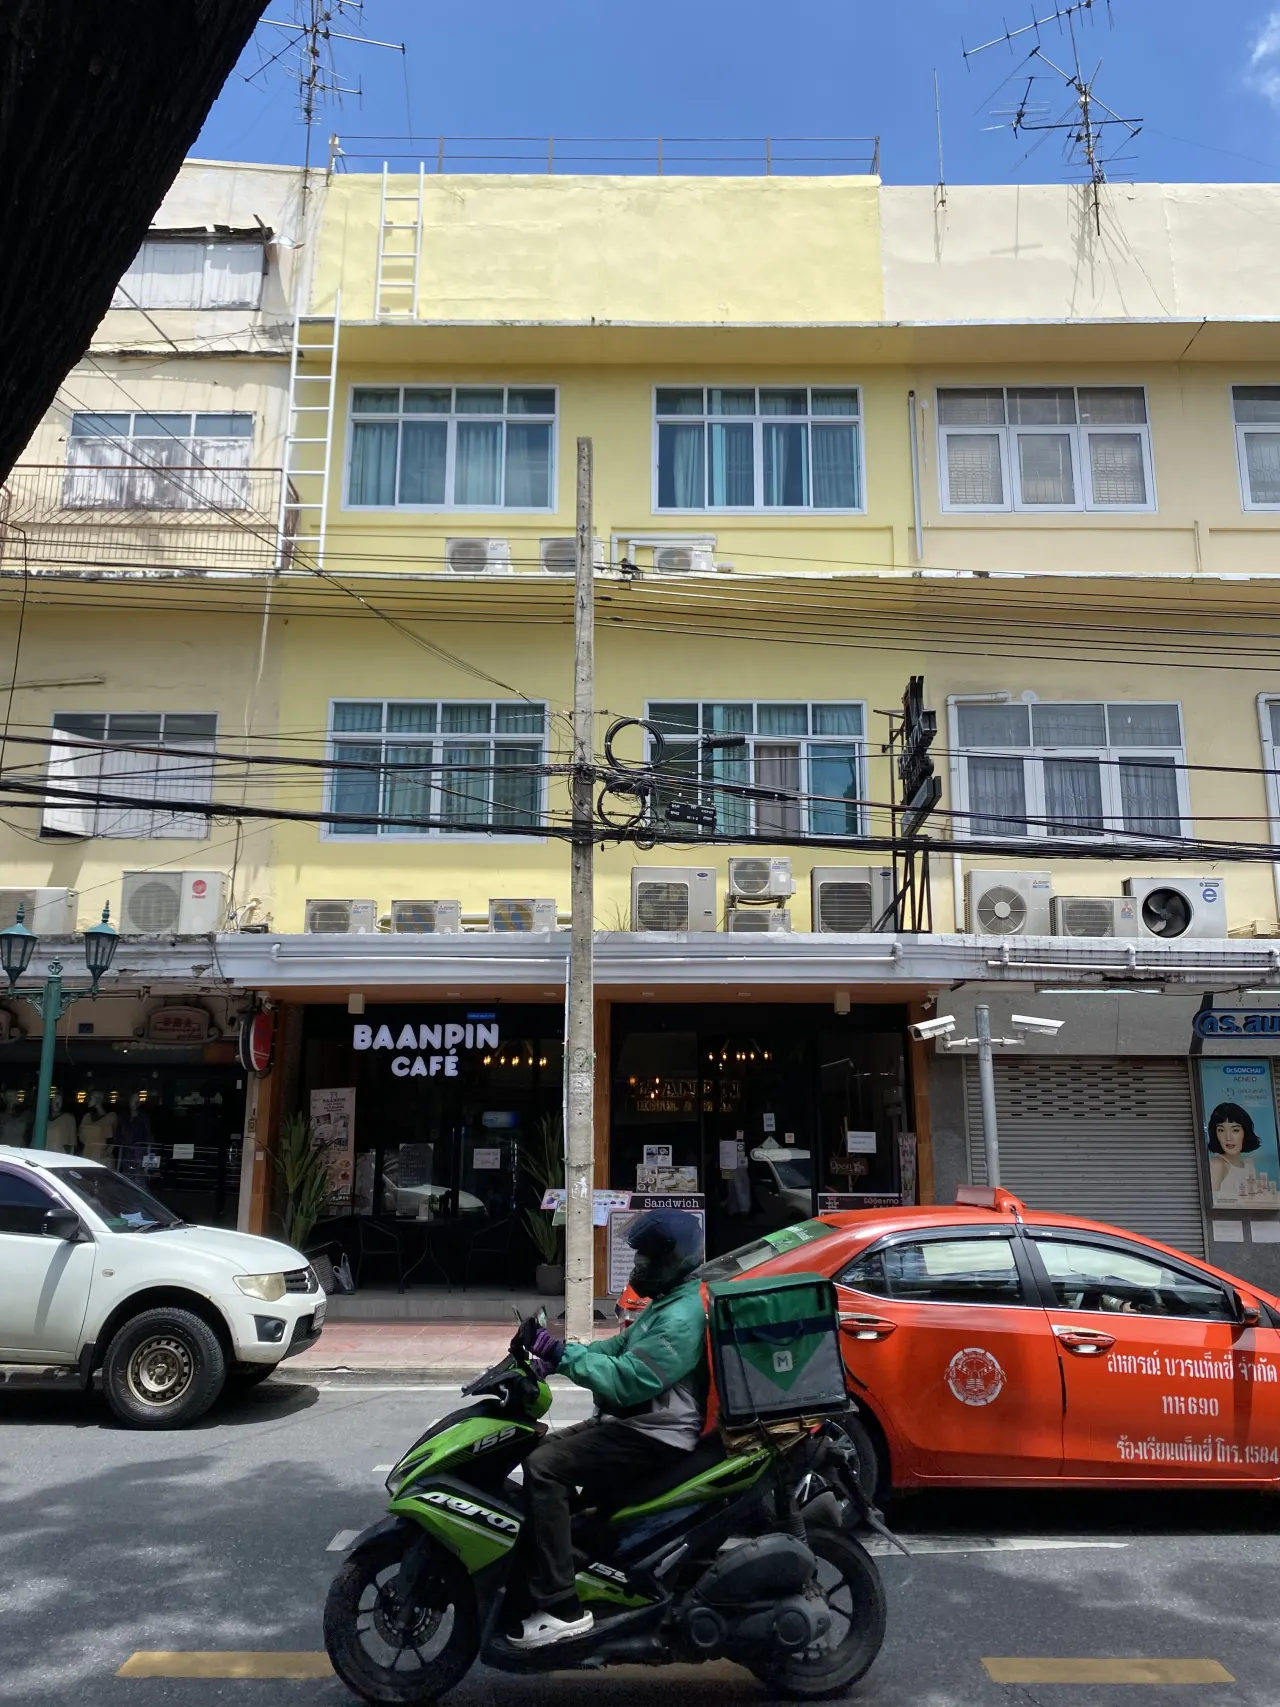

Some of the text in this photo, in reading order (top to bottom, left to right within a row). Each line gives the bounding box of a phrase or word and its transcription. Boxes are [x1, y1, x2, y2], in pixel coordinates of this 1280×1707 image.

[353, 1024, 499, 1050] BAANPIN
[391, 1047, 459, 1077] CAFÉ
[830, 1160, 852, 1173] Open
[644, 1198, 699, 1208] Sandwich
[1107, 1349, 1161, 1376] สหกรณ์
[1238, 1356, 1278, 1383] จำกัด
[472, 1425, 517, 1454] 155
